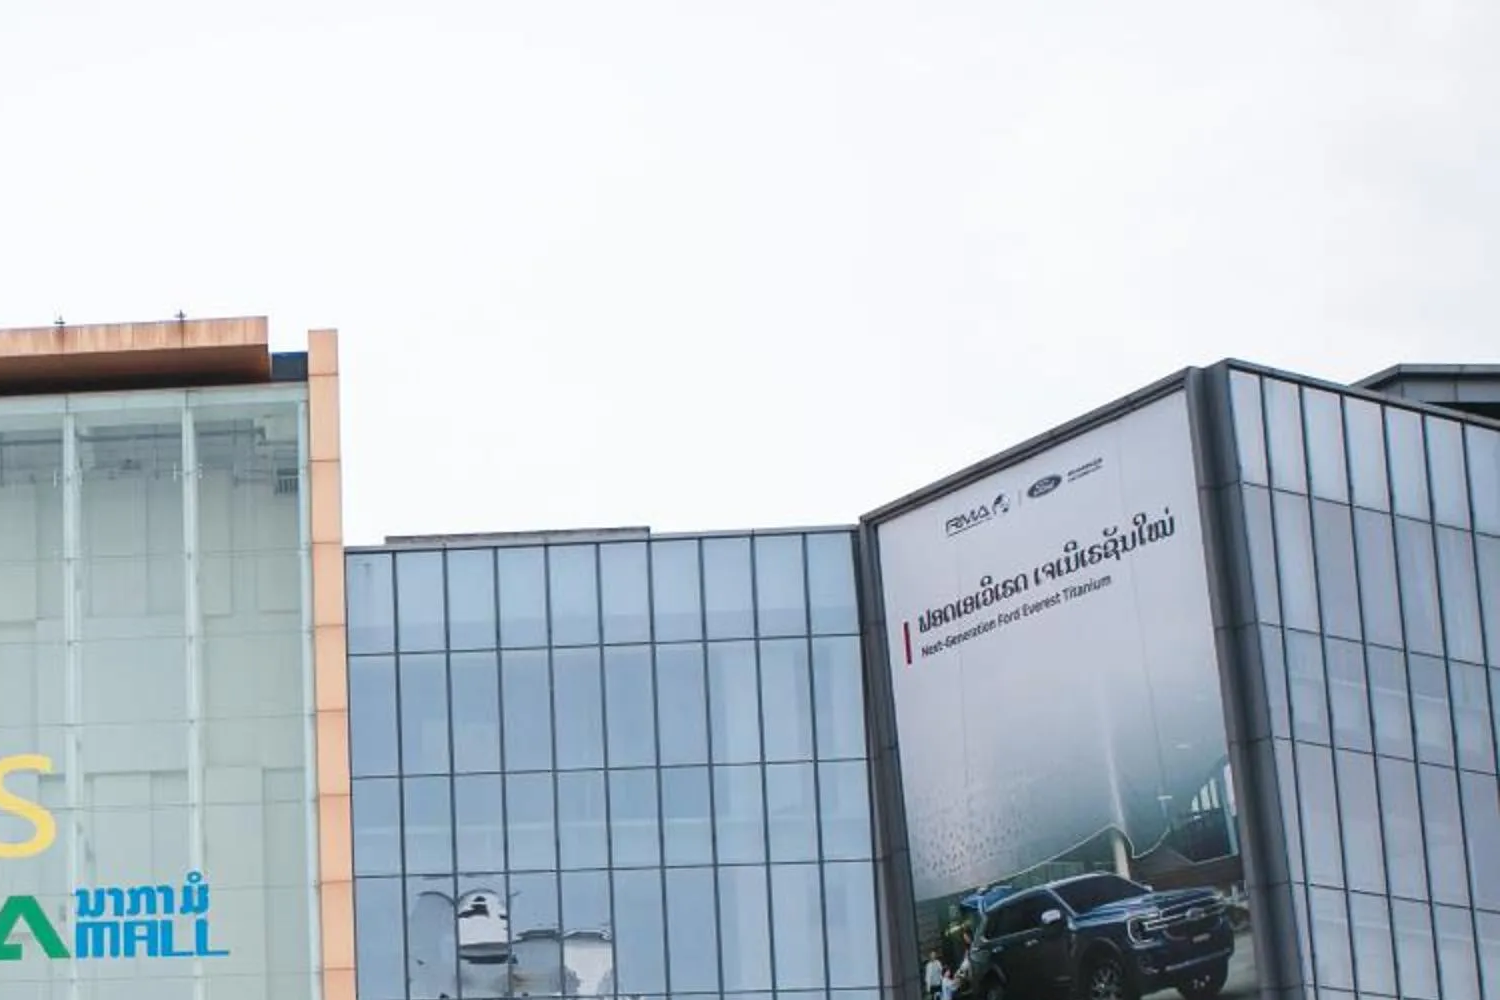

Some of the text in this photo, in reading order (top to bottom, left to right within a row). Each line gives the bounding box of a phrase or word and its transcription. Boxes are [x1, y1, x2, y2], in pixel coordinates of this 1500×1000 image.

[921, 574, 1112, 657] Next-Generation Ford Everest Titanium
[75, 919, 231, 959] MALL
